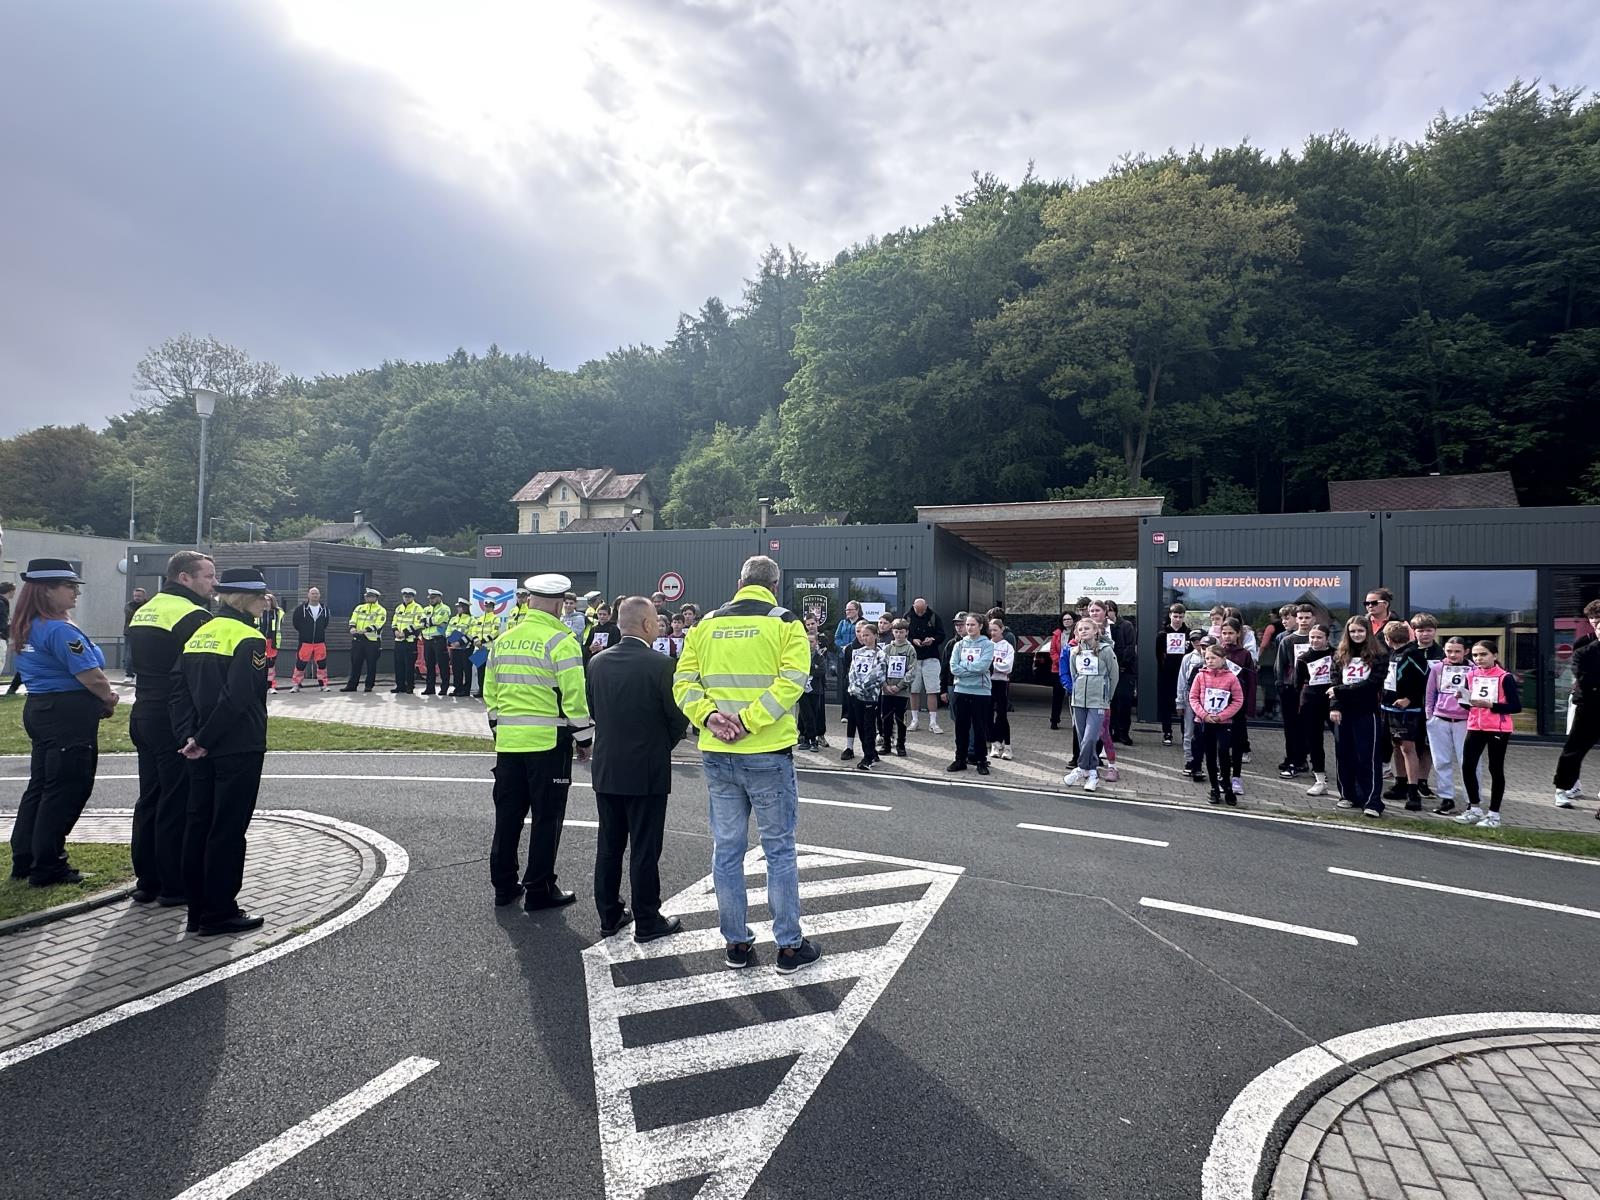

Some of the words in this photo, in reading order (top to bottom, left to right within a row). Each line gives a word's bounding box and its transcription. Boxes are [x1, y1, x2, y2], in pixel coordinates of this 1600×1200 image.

[1172, 577, 1213, 587] PAVILON
[1215, 576, 1281, 588] BEZPEČNOSTI
[1283, 578, 1291, 587] V
[1293, 575, 1341, 588] DOPRAVĚ
[712, 629, 760, 639] BESIP
[497, 640, 544, 653] POLICIE
[659, 643, 665, 651] 2
[1170, 639, 1182, 647] 20
[891, 662, 903, 671] 15
[1083, 657, 1091, 667] 9
[856, 663, 869, 673] 13
[1315, 665, 1329, 676] 22
[1347, 666, 1364, 677] 21
[1451, 674, 1461, 685] 6
[1479, 686, 1489, 698] 5
[1209, 697, 1225, 708] 17
